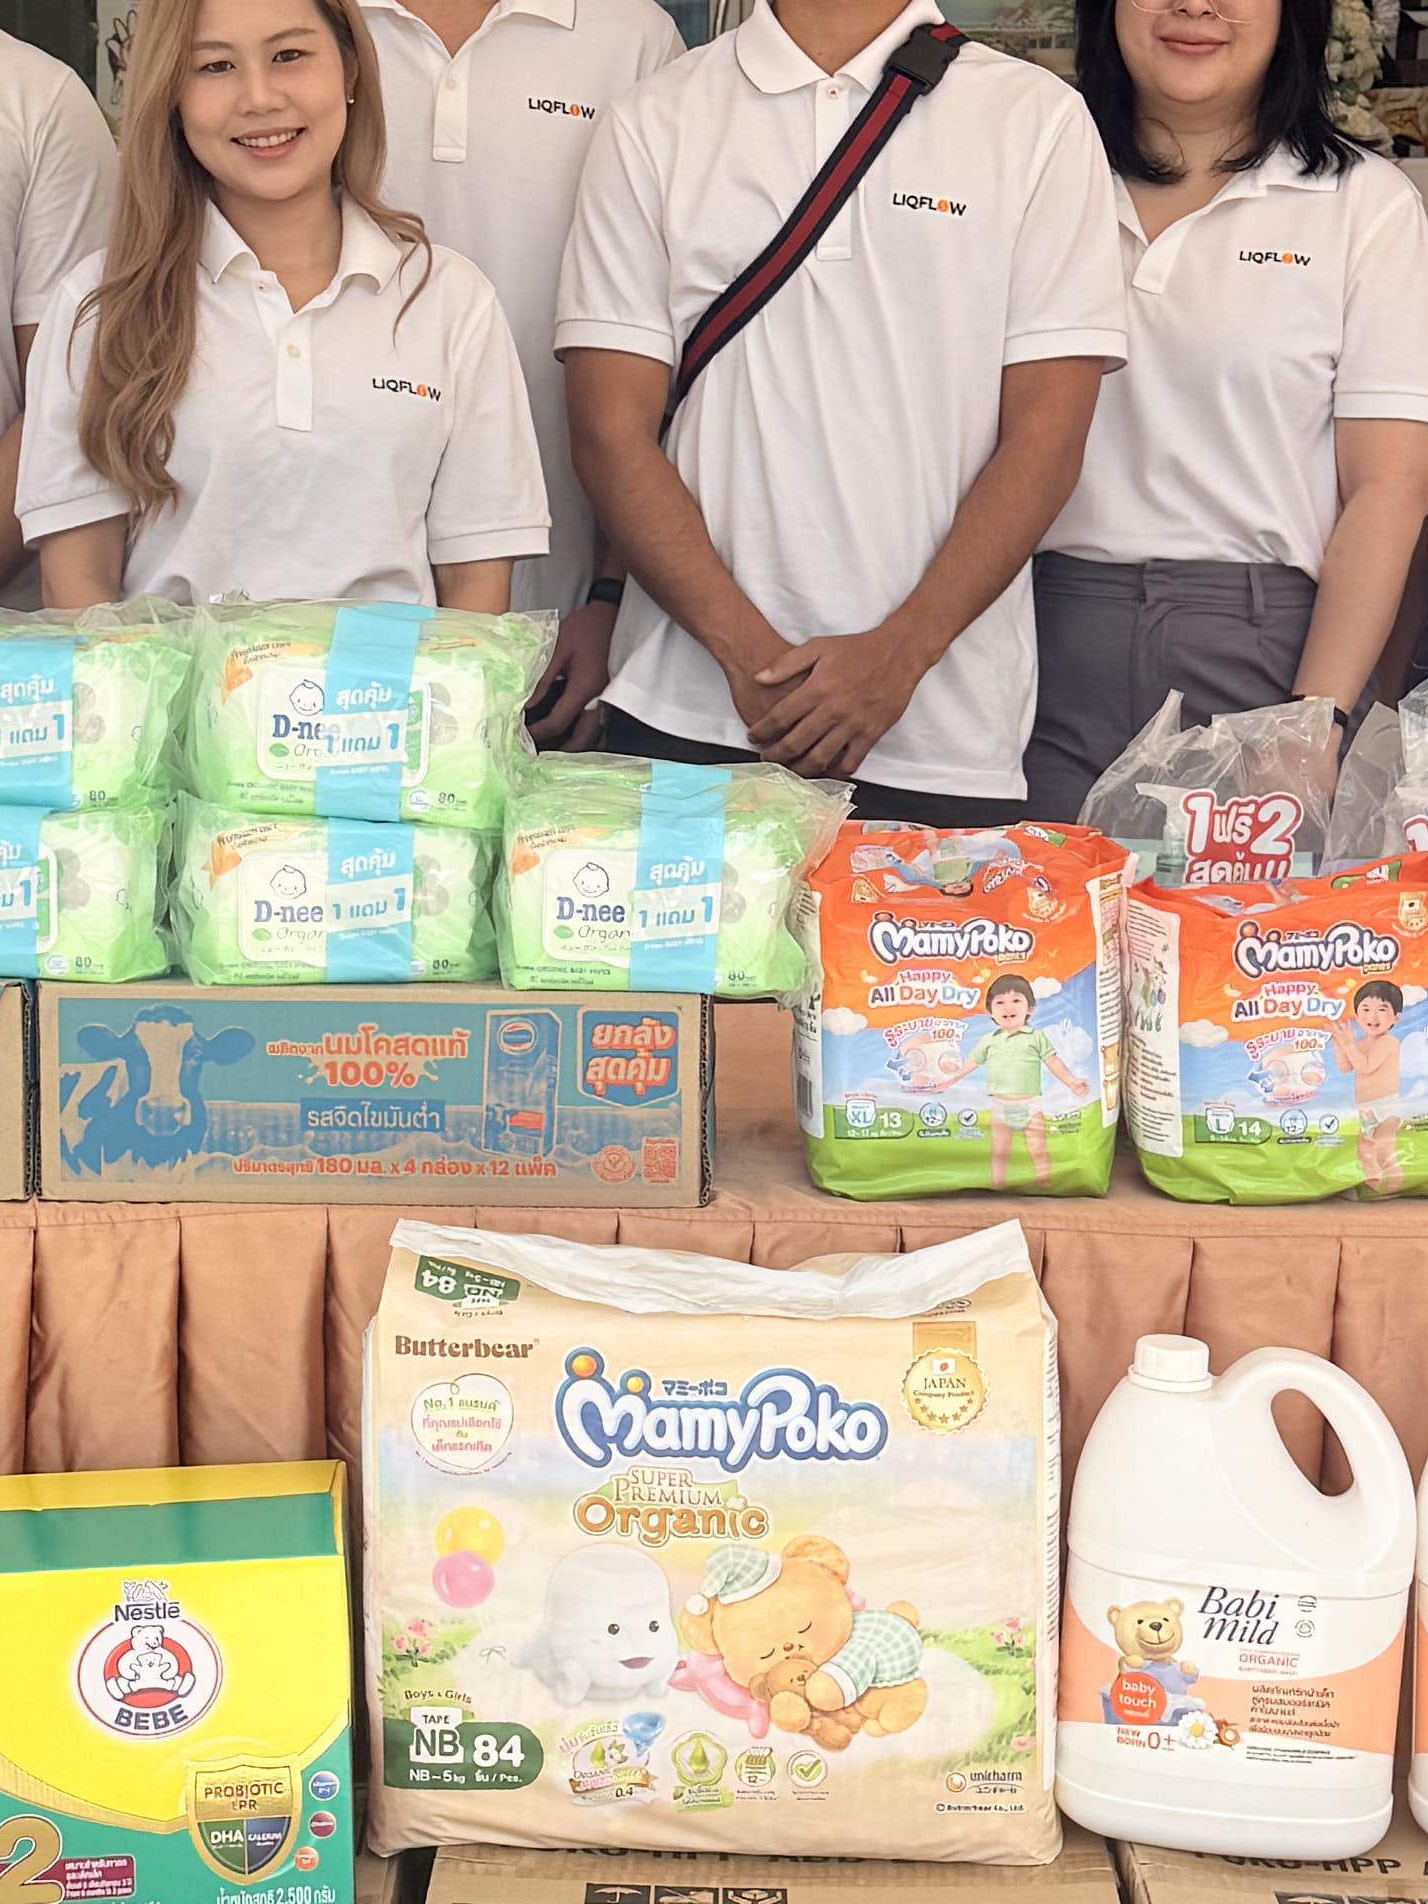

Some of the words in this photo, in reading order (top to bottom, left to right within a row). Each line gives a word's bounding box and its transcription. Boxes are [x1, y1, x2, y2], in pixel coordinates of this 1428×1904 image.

[528, 97, 595, 120] LIQFLOW
[892, 192, 966, 216] LIQFLOW
[1239, 248, 1311, 266] LIQFLOW
[372, 377, 441, 402] LIQFLOW
[0, 674, 55, 702] สุดคุ้ม
[335, 684, 392, 712] สุดคุ้ม
[8, 724, 47, 744] แถม
[51, 714, 66, 741] 1
[339, 848, 397, 877] สุดคุ้ม
[649, 856, 705, 885] สุดคุ้ม
[253, 900, 323, 925] D-nee
[556, 896, 625, 923] D-nee
[868, 911, 1035, 966] MamyPoko
[1233, 921, 1400, 978] MamyPoko
[899, 971, 951, 985] Happy
[870, 986, 896, 1004] All
[900, 986, 938, 1004] Day
[943, 987, 980, 1006] Dry
[321, 1025, 469, 1061] นมโคสดแท้
[590, 1016, 676, 1050] ยกลัง
[322, 1061, 417, 1088] 100%
[586, 1054, 671, 1094] สุดคุ้ม
[307, 1106, 443, 1131] รสจืดไขมันต่ำ
[850, 1111, 872, 1124] XL
[1237, 1119, 1261, 1136] 14
[395, 1335, 533, 1360] Butterbear
[922, 1377, 967, 1390] JAPAN
[556, 1346, 887, 1470] MamyPoko
[630, 1468, 692, 1488] SUPER
[615, 1484, 723, 1506] PREMIUM
[574, 1495, 769, 1546] Organic
[1197, 1585, 1280, 1619] Babi
[1238, 1651, 1301, 1669] ORGANIC
[1121, 1679, 1158, 1697] baby
[1118, 1693, 1158, 1709] touch
[114, 1704, 189, 1731] BEBE
[421, 1713, 451, 1726] TAPE
[413, 1727, 461, 1759] NB
[472, 1735, 525, 1767] 84
